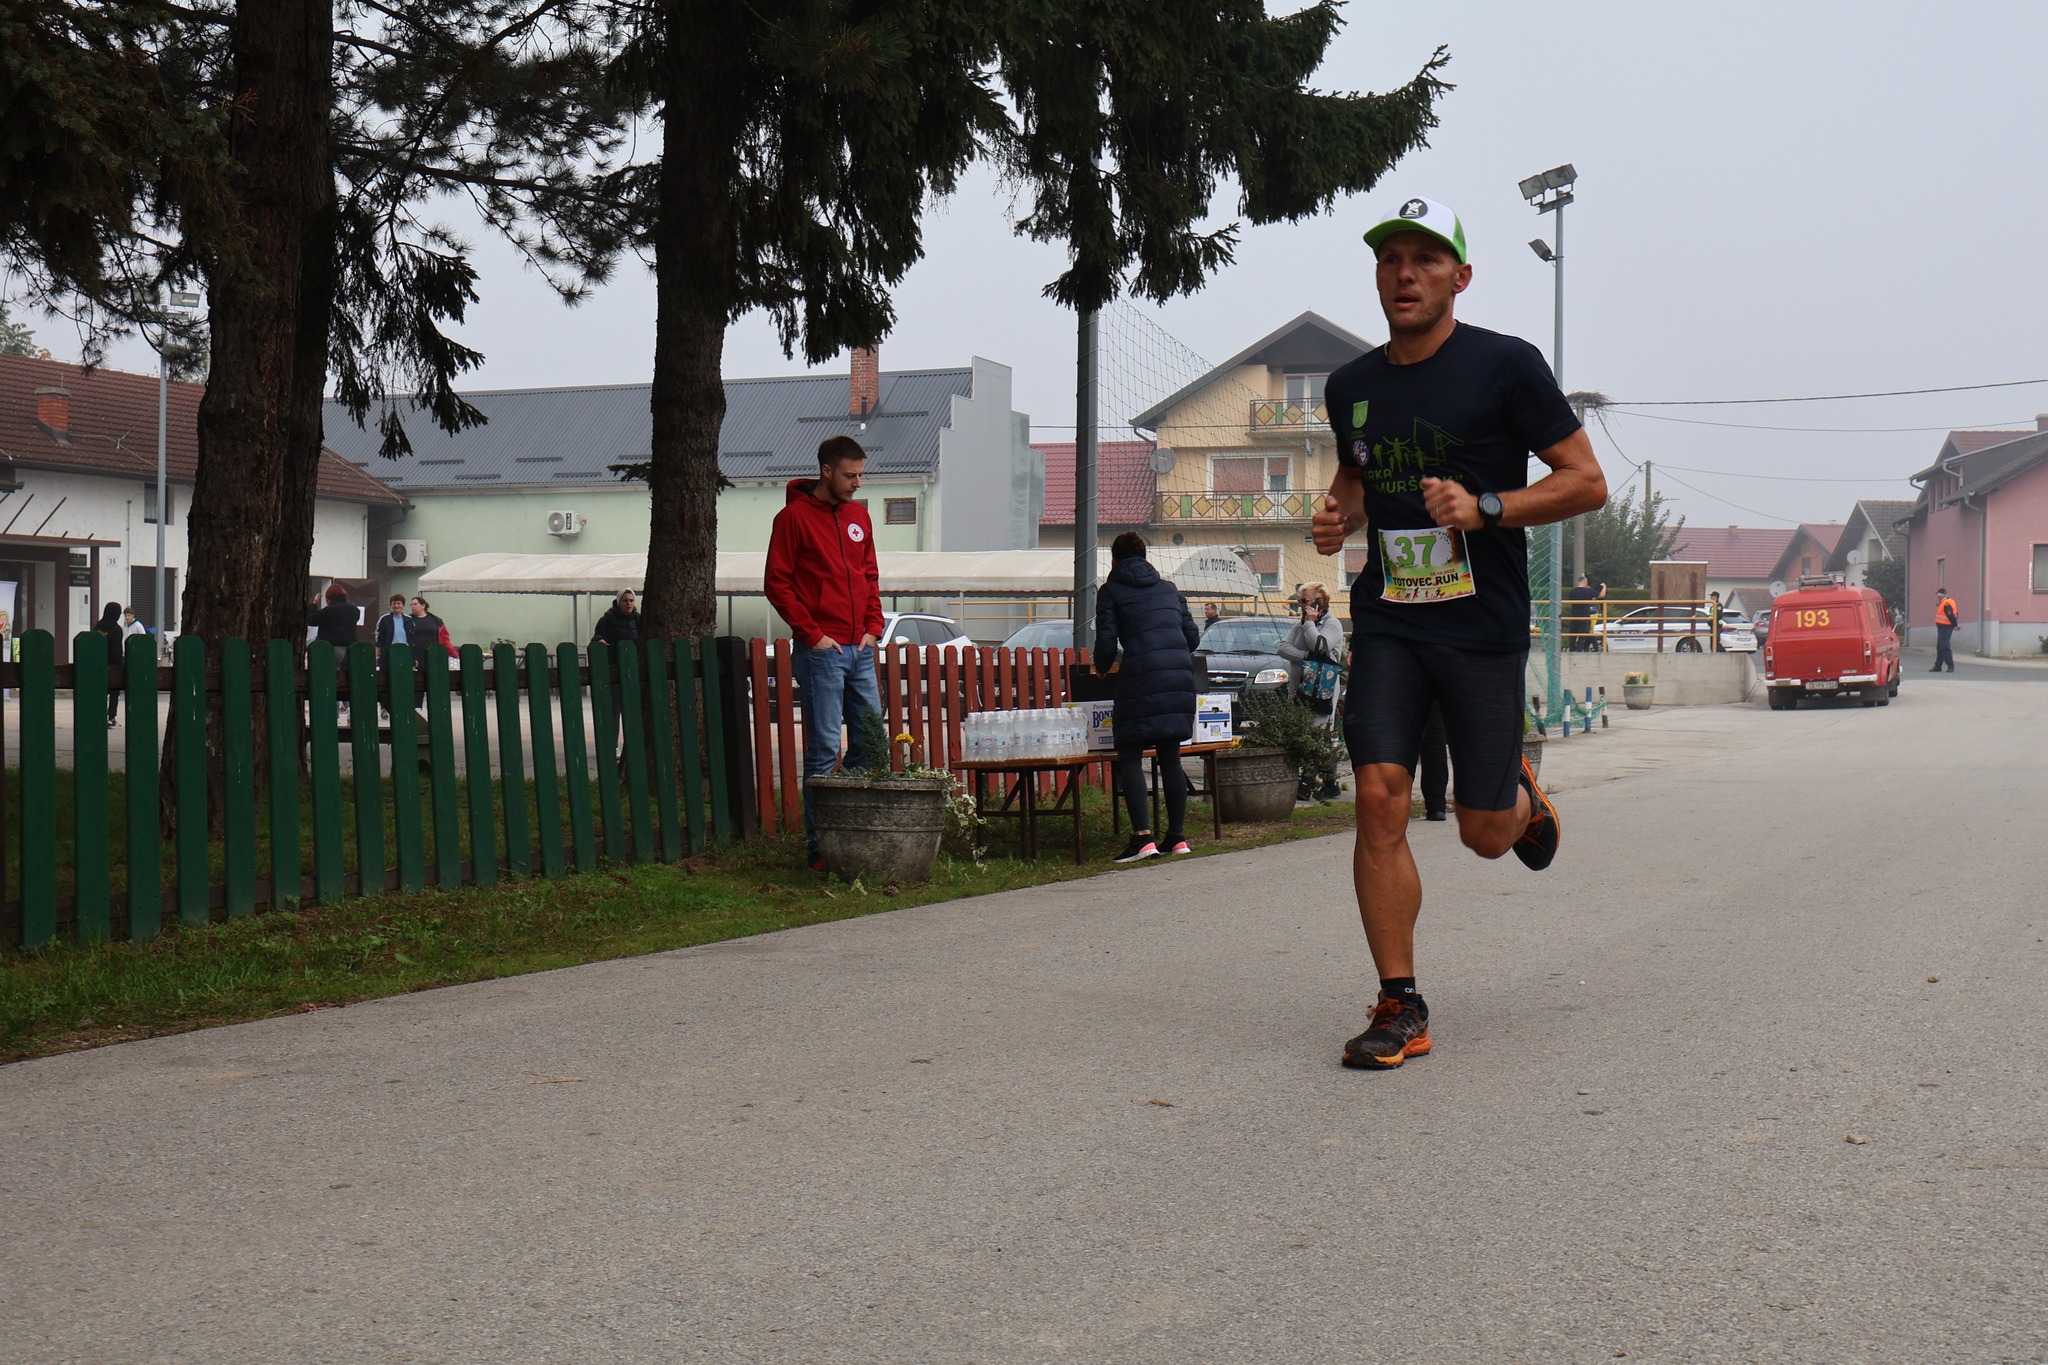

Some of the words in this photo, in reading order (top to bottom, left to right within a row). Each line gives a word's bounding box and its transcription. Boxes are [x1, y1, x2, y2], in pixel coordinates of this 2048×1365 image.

[1394, 535, 1437, 565] 37
[1211, 558, 1236, 573] TOTOVEC
[1392, 577, 1432, 587] TOTOVEC
[1435, 572, 1459, 585] RUN
[1795, 609, 1830, 628] 193
